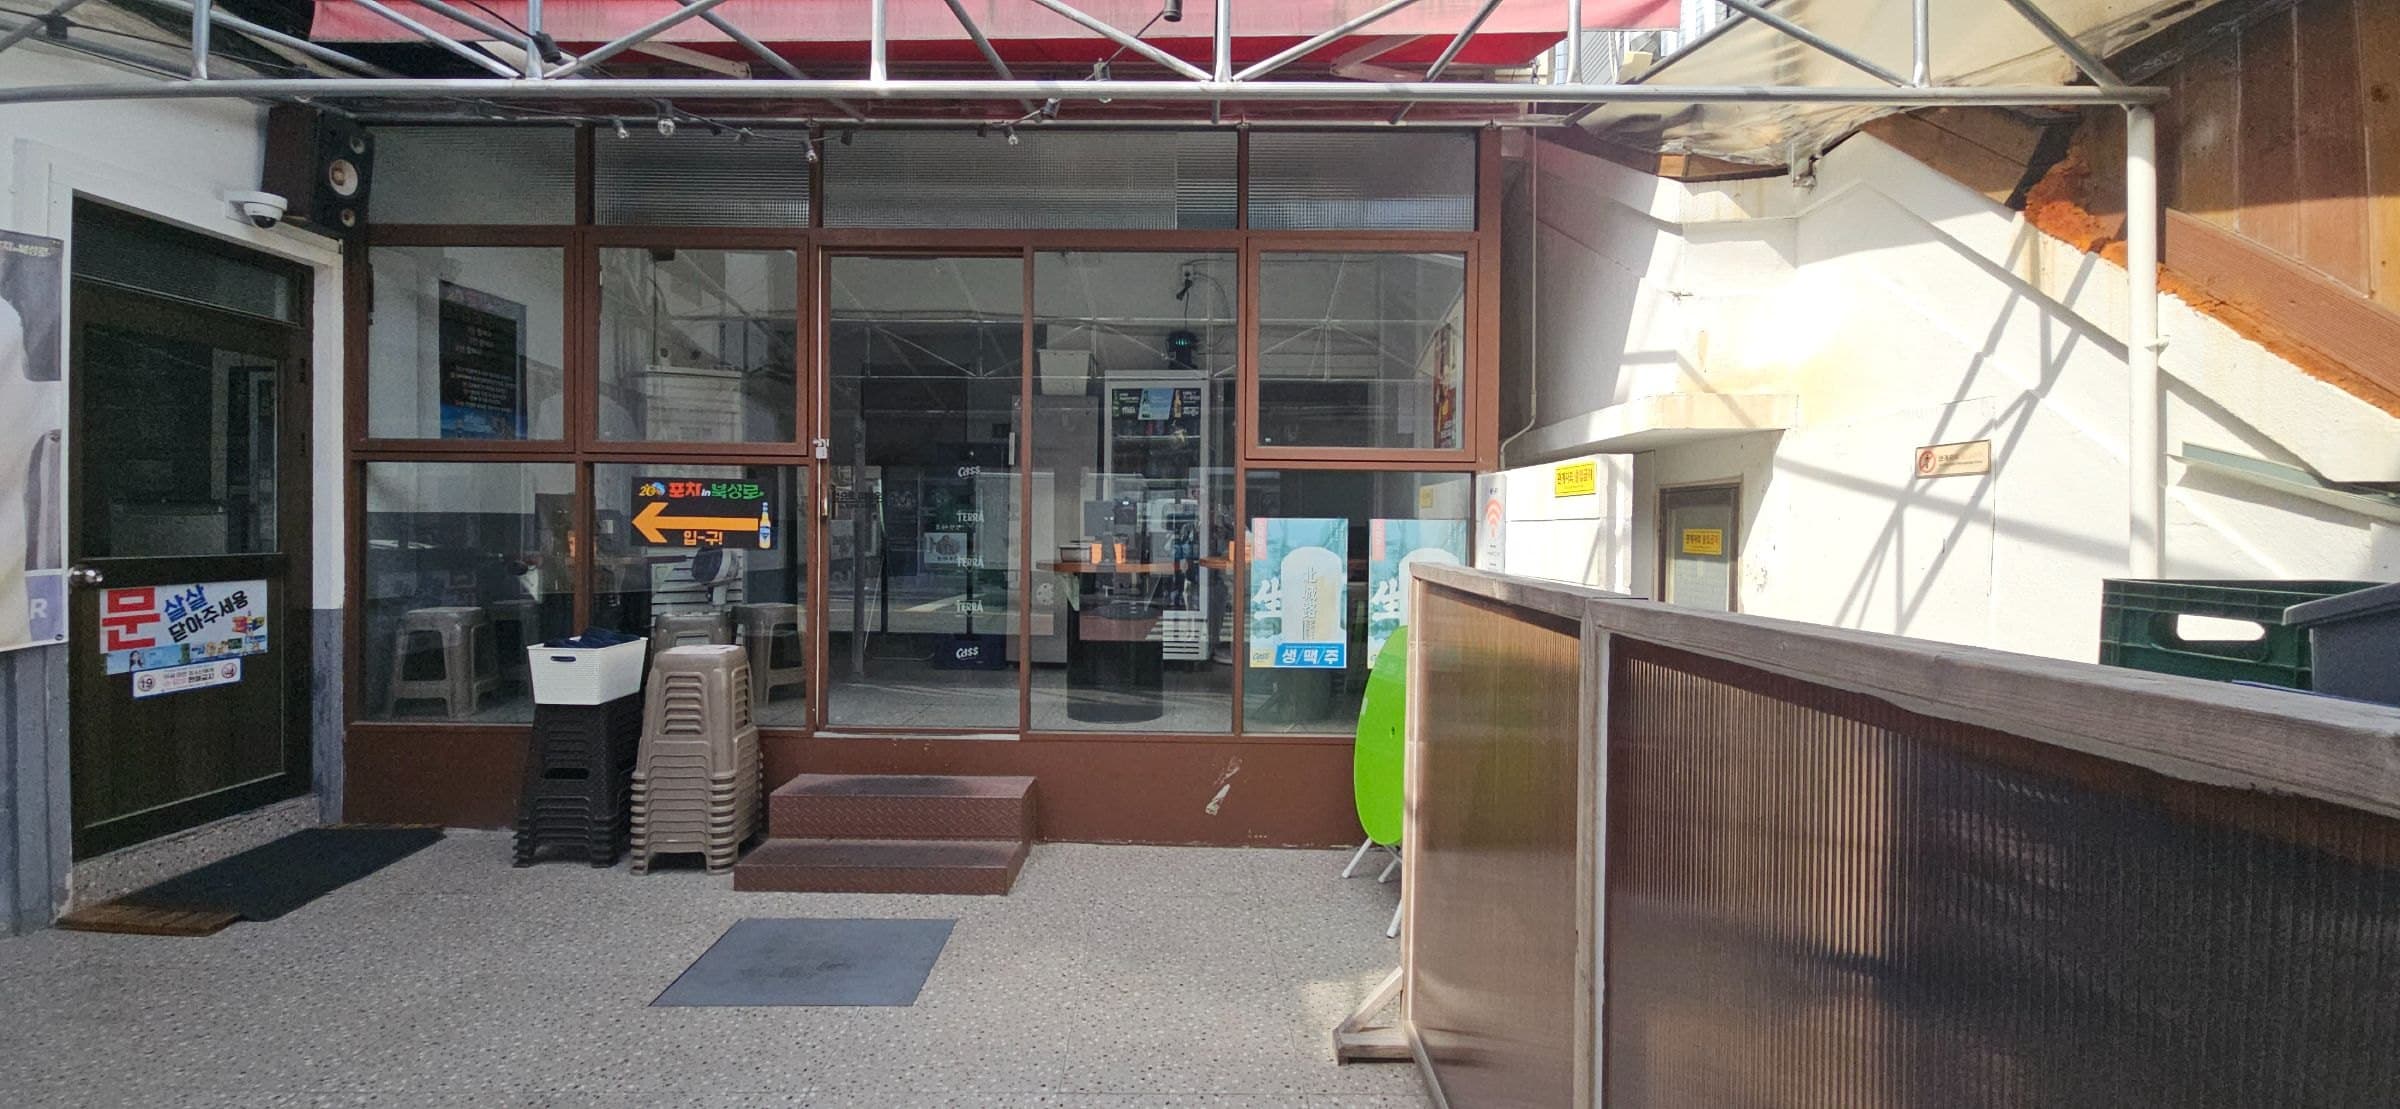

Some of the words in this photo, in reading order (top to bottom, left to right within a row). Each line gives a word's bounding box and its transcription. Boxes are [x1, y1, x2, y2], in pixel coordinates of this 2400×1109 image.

[958, 466, 981, 478] Cass
[668, 482, 702, 498] 포차
[711, 483, 764, 499] 북성로
[957, 510, 984, 522] TERRA
[957, 555, 984, 569] TERRA
[164, 584, 208, 622] 살살
[956, 600, 983, 613] TERRA
[102, 587, 160, 651] 문
[168, 590, 249, 643] 닫아주세용
[956, 646, 979, 659] Cass
